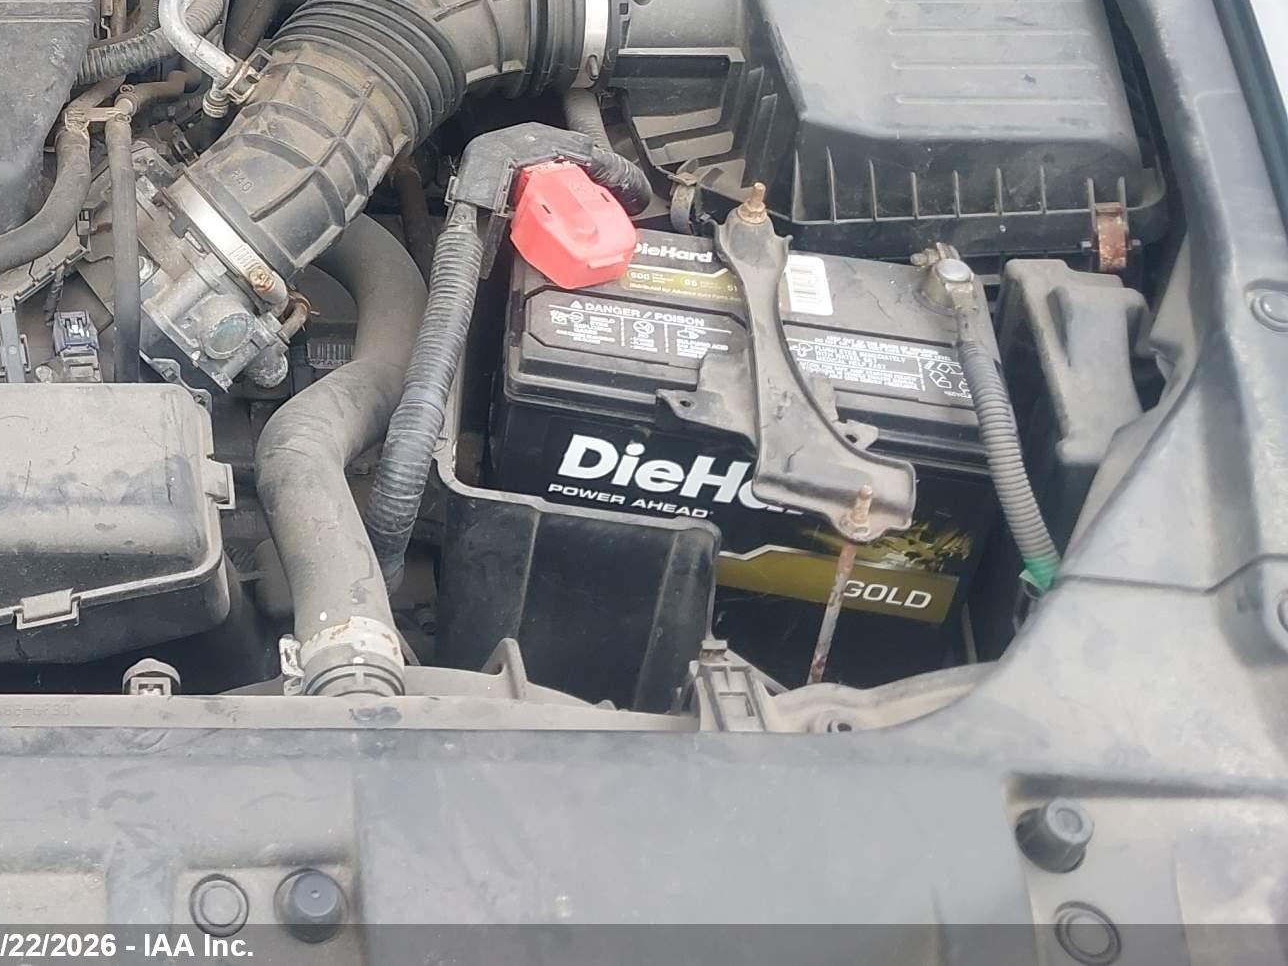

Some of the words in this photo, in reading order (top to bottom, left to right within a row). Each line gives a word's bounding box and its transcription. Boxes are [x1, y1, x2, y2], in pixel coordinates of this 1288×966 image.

[585, 302, 641, 318] DANGER
[654, 312, 705, 327] POISON
[557, 434, 803, 515] DieH
[547, 483, 626, 505] POWER
[631, 497, 708, 520] AHEAD
[843, 580, 932, 609] GOLD
